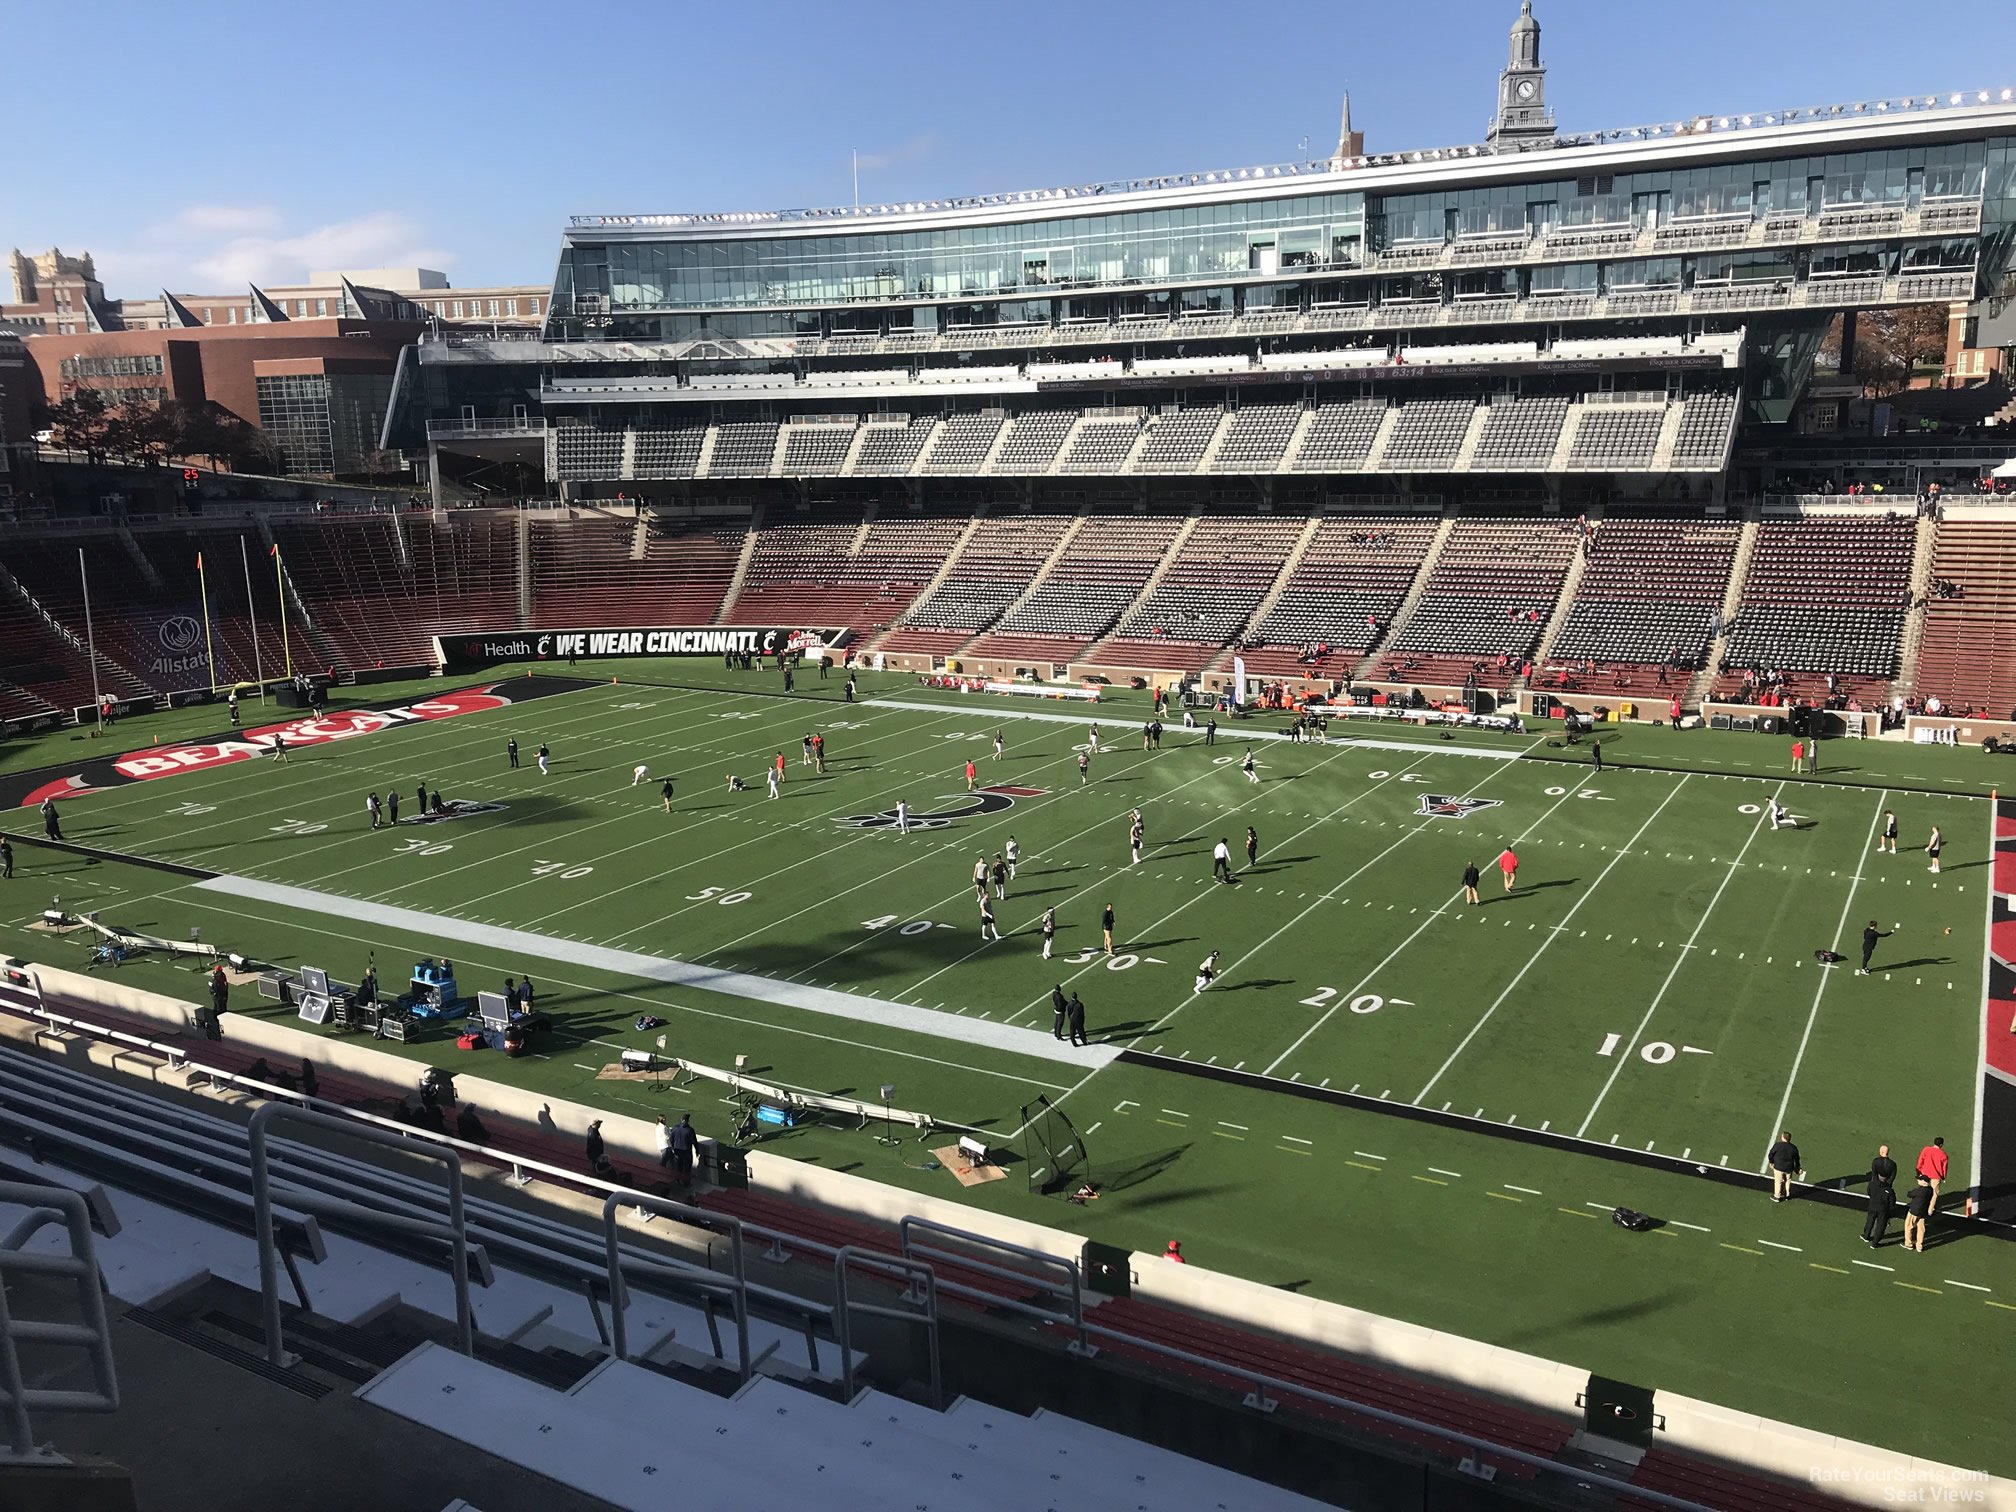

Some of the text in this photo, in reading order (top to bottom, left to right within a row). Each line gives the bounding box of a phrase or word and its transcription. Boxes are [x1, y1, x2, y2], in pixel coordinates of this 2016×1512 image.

[1391, 367, 1425, 378] 63:14
[184, 469, 199, 480] 25
[556, 631, 758, 656] WE WEAR CINCINNATI
[785, 635, 823, 652] Morrell
[799, 631, 816, 640] John
[484, 640, 531, 656] Health
[149, 651, 214, 673] Allstate
[112, 701, 459, 778] BEARCATS
[1544, 787, 1602, 800] 20
[269, 820, 328, 834] 20
[393, 840, 453, 855] 30
[531, 862, 593, 879] 40
[685, 886, 752, 905] 50
[860, 914, 933, 935] 40
[1063, 947, 1139, 971] 30
[1299, 986, 1384, 1014] 20
[1596, 1033, 1676, 1064] 10
